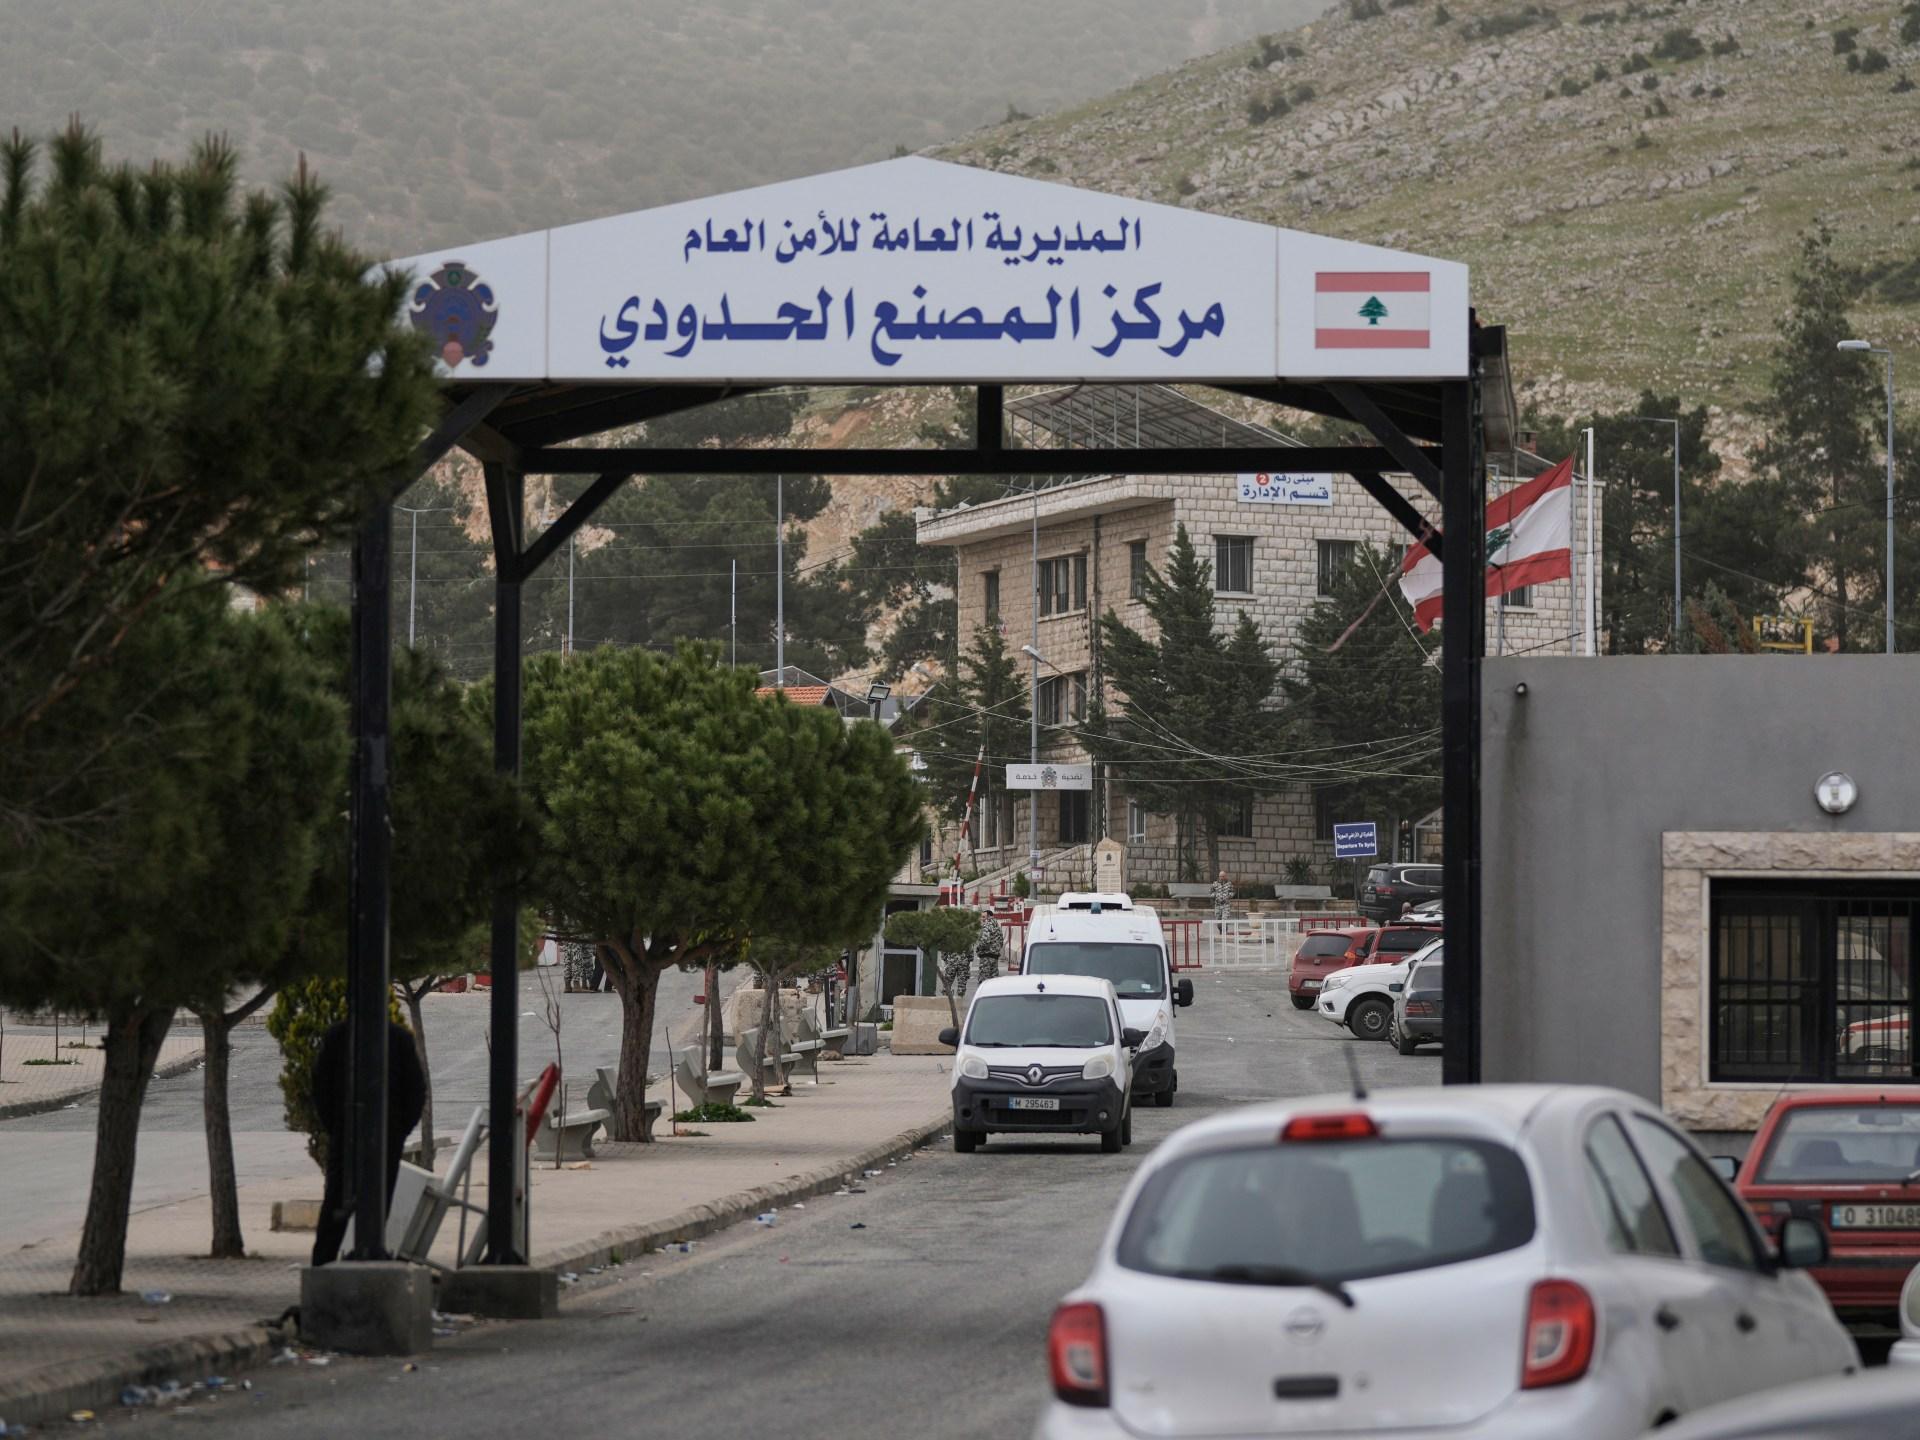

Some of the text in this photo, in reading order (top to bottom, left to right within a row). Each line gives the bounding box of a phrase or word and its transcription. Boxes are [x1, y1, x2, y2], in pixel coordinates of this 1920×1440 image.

[684, 210, 1141, 266] المديرية العامة للأمن العام
[600, 281, 1225, 369] مركز المصنع الحدودي
[1259, 474, 1266, 484] 2
[1242, 484, 1329, 501] قسم الإدارة
[1364, 841, 1375, 849] Syria
[1014, 1098, 1054, 1109] M 295463
